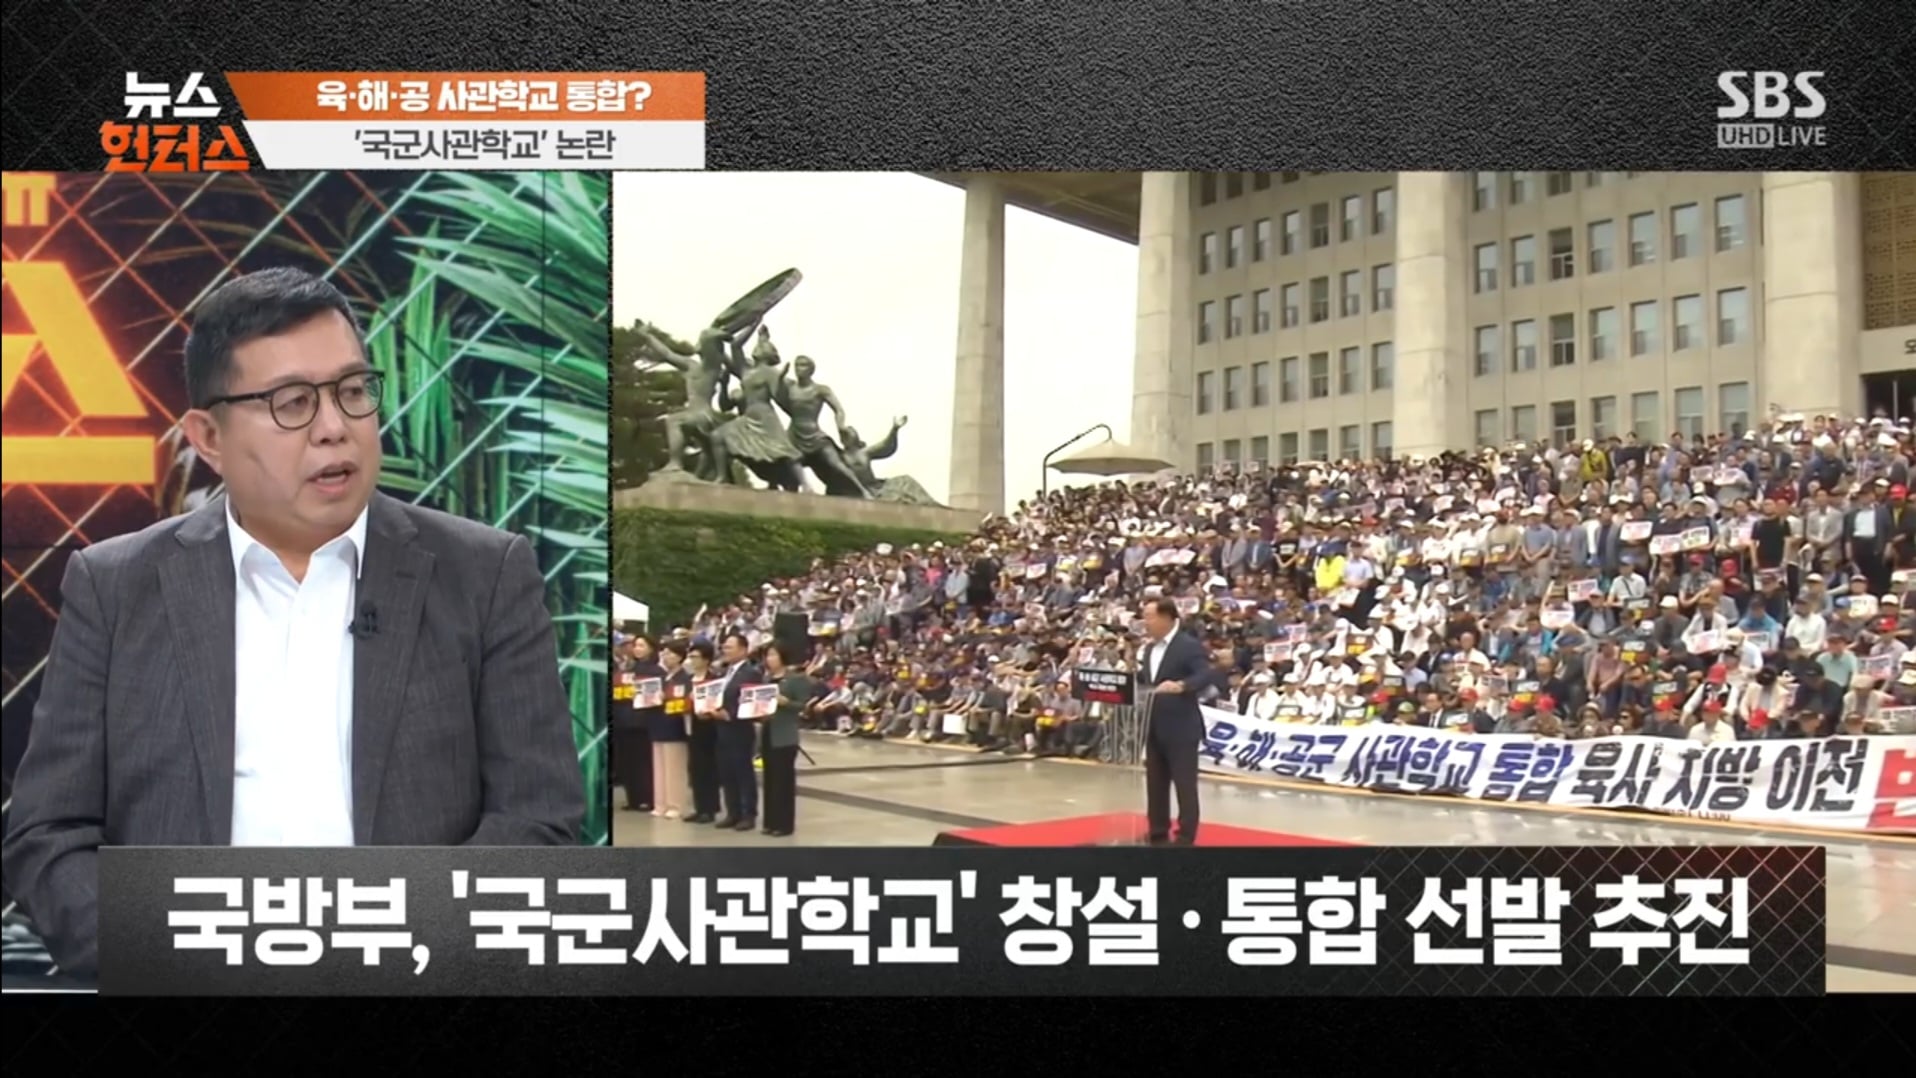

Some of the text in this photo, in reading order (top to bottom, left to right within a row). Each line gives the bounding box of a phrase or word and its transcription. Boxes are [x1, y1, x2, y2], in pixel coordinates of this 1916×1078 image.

[1341, 735, 1487, 795] 사관학교
[1480, 743, 1576, 804] 통합
[1571, 742, 1662, 806] 육사
[1661, 746, 1762, 811] 지방
[1766, 738, 1869, 812] 이전
